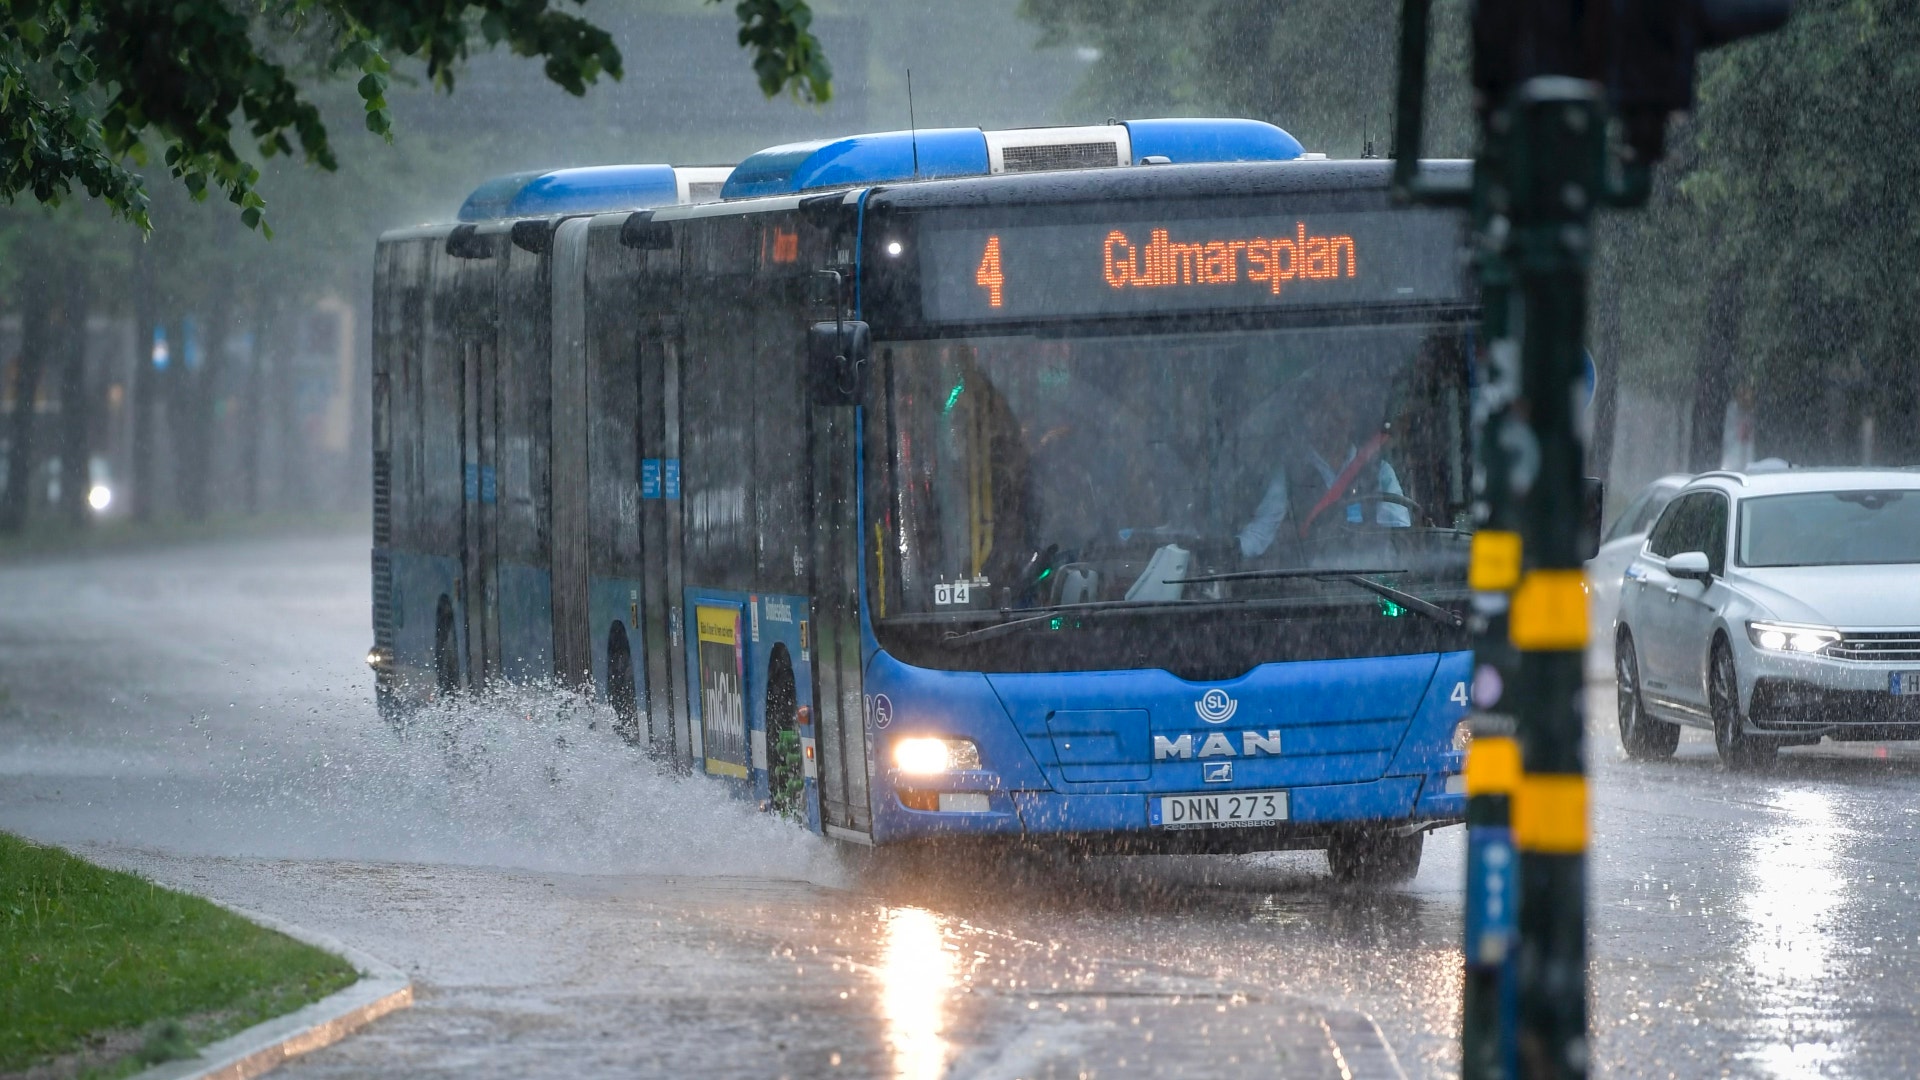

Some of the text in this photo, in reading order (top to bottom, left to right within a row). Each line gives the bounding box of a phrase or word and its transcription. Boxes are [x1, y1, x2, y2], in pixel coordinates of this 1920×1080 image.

[977, 221, 1357, 307] 4 Gullmarsplan
[1207, 695, 1226, 709] SL
[1153, 729, 1282, 760] MAN
[1172, 795, 1277, 822] DNN 273
[1211, 819, 1277, 830] HORNSBERG
